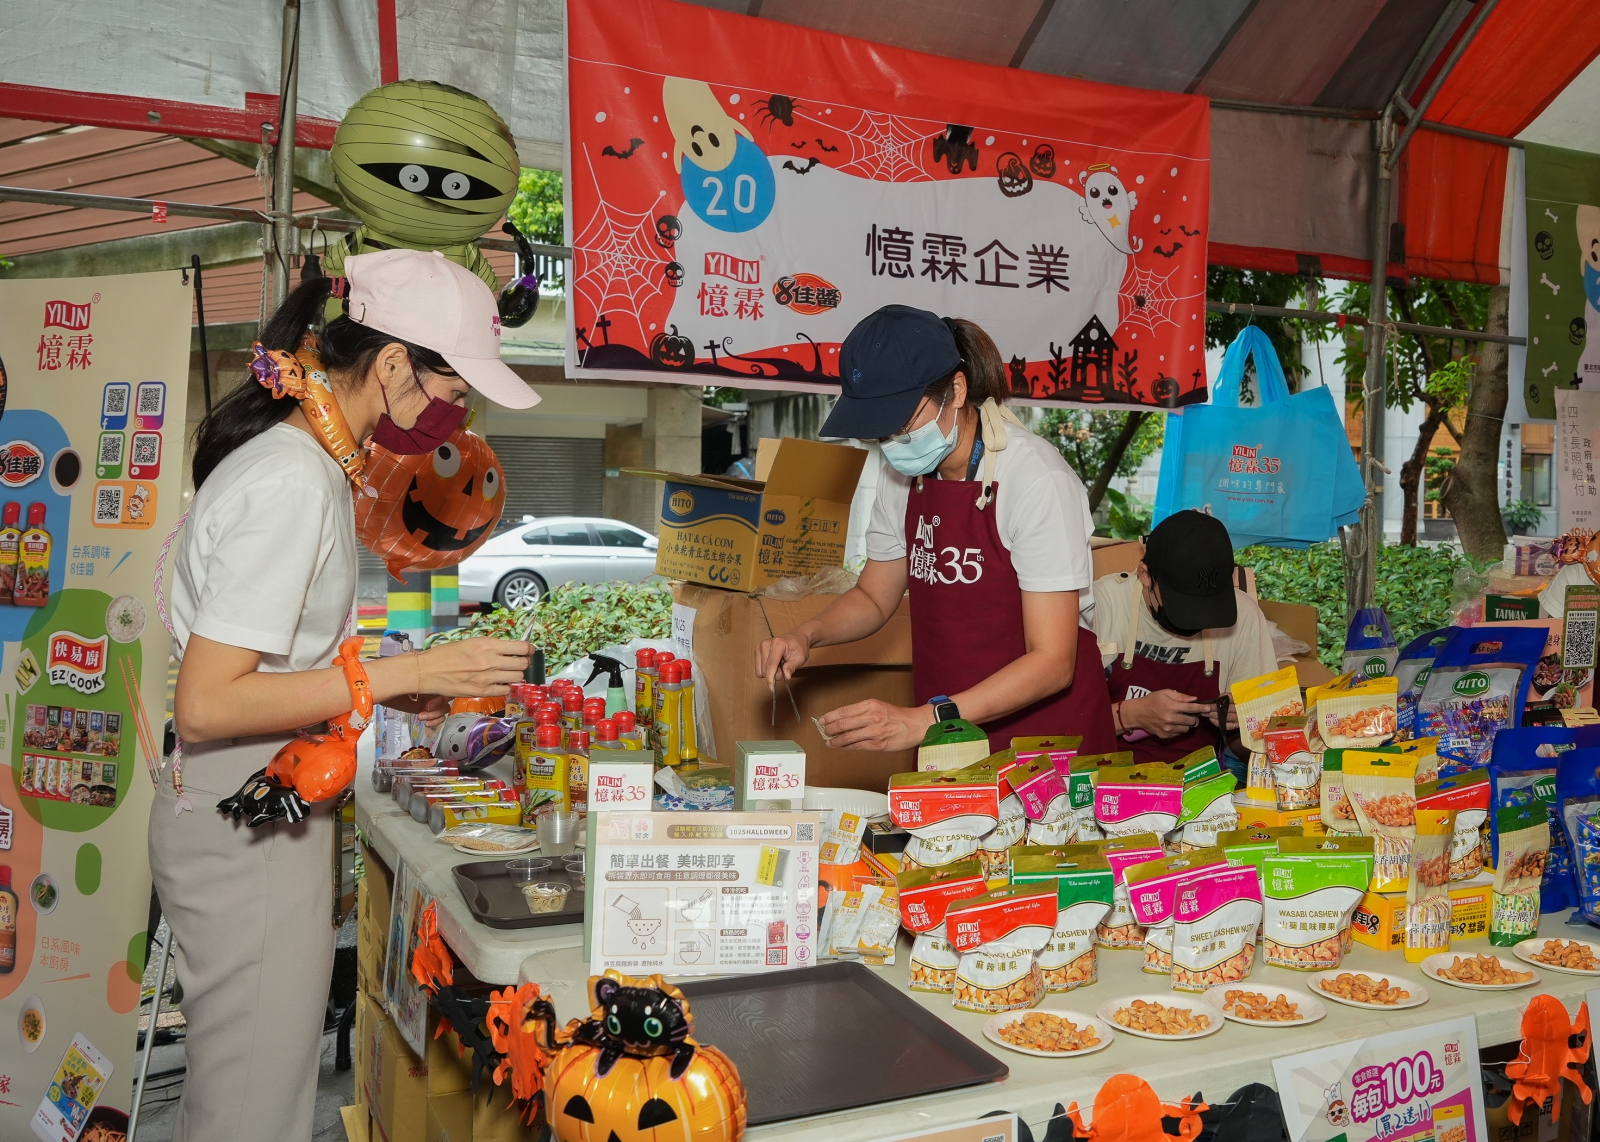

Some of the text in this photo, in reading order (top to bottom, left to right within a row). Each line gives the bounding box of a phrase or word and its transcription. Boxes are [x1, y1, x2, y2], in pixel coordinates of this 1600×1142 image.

[702, 174, 756, 216] 20
[865, 223, 1070, 294] 憶霖企業
[706, 253, 759, 284] YILIN
[775, 275, 840, 309] 8佳醬
[697, 282, 765, 321] 憶霖
[47, 303, 90, 328] YILIN
[36, 333, 94, 371] 憶霖
[1233, 446, 1257, 459] YILIN
[1567, 406, 1586, 497] 四大長照給付
[1583, 438, 1597, 496] 政府有補助
[671, 497, 692, 508] HITO
[767, 513, 784, 522] HITO
[72, 545, 111, 560] 台系調味
[758, 548, 784, 565] 憶霖
[70, 562, 95, 577] 8佳醬
[1495, 608, 1527, 620] TAIWAN
[55, 641, 100, 667] 快易廚
[1365, 663, 1386, 674] HITO
[1457, 678, 1487, 689] HITO
[756, 766, 779, 777] YILIN
[598, 776, 622, 788] YILIN
[1536, 784, 1557, 797] HIT
[900, 801, 920, 811] YILIN
[1103, 794, 1119, 805] YILIN
[1102, 804, 1119, 816] 憶霖
[610, 853, 736, 869] 簡單出餐 美味即享
[1273, 868, 1292, 878] YILIN
[1271, 878, 1295, 891] 憶霖
[1140, 892, 1160, 903] YILIN
[908, 902, 926, 914] YILIN
[1142, 902, 1164, 917] 憶霖
[1179, 901, 1200, 915] 憶霖
[1279, 910, 1340, 919] WASABI CASHEW
[910, 913, 931, 927] 憶霖
[1279, 920, 1336, 932] 山葵風味腰果
[957, 921, 979, 933] YILIN
[956, 932, 982, 947] 憶霖
[1056, 929, 1087, 939] CASHEW
[1190, 931, 1212, 943] SWEET
[1213, 927, 1240, 938] CASHEW
[41, 936, 81, 957] 日系風味
[39, 954, 70, 972] 本廚房
[975, 959, 1018, 972] 麻辣腰果
[1444, 1043, 1459, 1053] YILIN
[1444, 1052, 1462, 1066] 憶霖
[408, 1065, 429, 1078] 常溫
[1354, 1067, 1379, 1084] 零食首選
